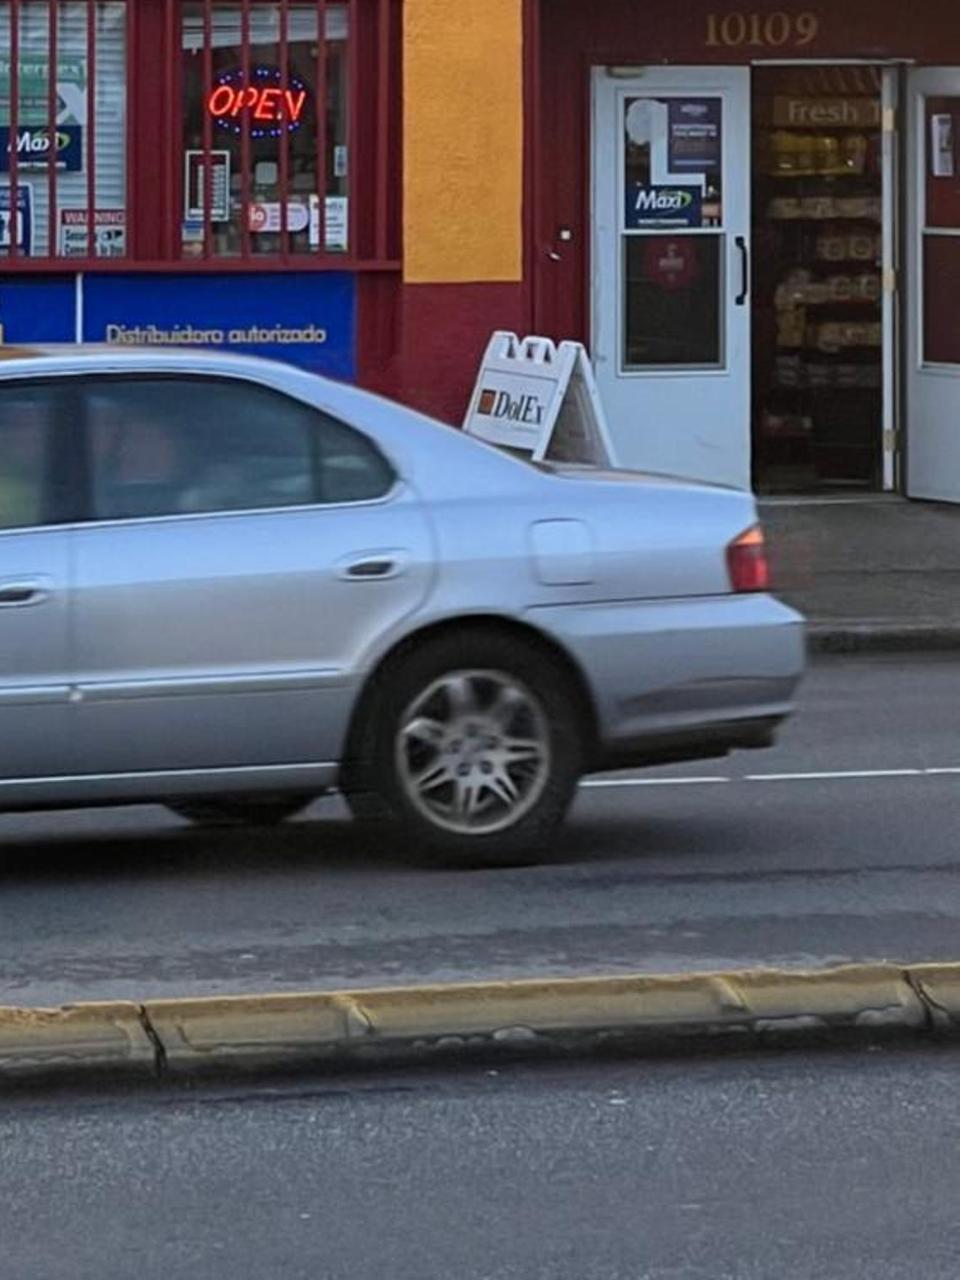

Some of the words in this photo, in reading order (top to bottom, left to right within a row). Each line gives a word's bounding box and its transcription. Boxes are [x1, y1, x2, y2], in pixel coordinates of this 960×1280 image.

[704, 12, 818, 46] 10109
[208, 85, 305, 121] OPEN
[788, 100, 858, 122] Fresh
[635, 190, 681, 210] Maxi
[64, 211, 125, 224] WANING
